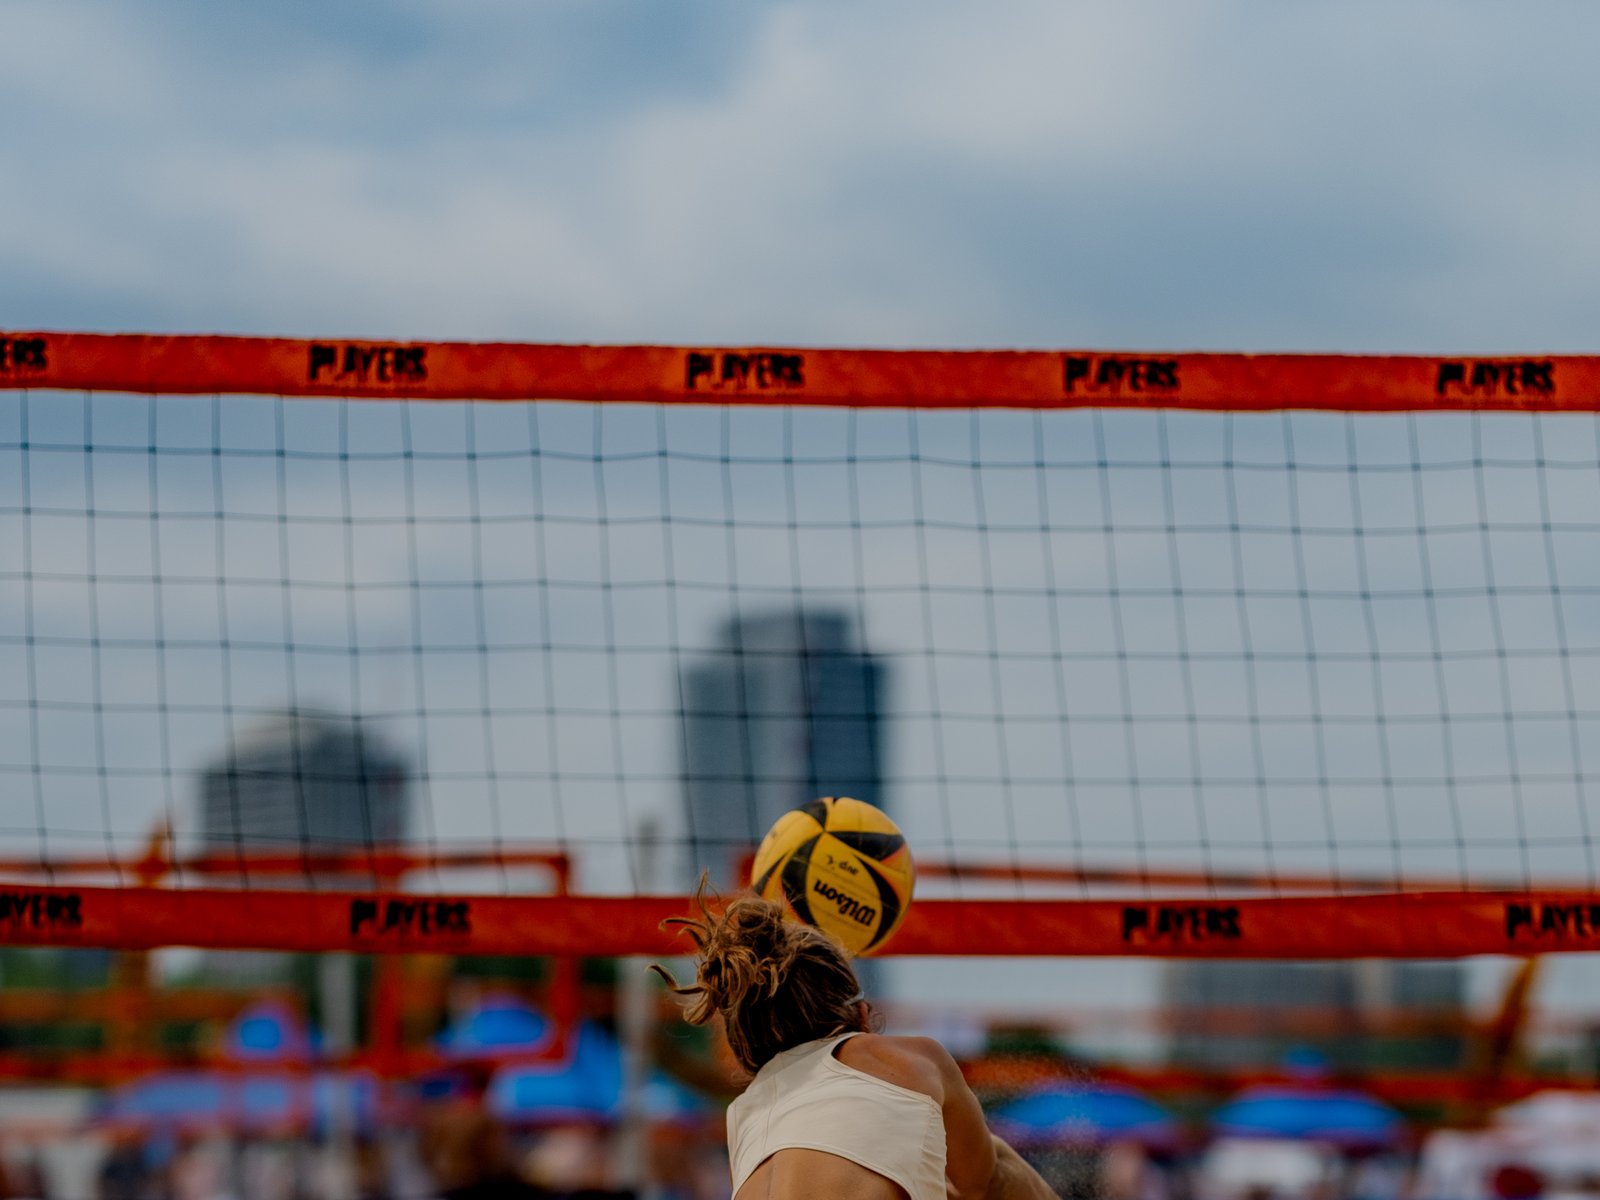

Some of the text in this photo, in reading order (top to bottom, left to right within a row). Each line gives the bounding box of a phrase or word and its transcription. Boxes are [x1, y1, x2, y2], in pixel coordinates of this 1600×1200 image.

[308, 344, 428, 382] PLAYERS
[686, 351, 805, 389] PLAYERS
[1065, 356, 1179, 392] PLAYERS
[1438, 361, 1553, 394] PLAYERS
[351, 900, 469, 935] PLAYERS
[814, 880, 875, 926] Wilson
[1123, 906, 1241, 940] PLAYERS
